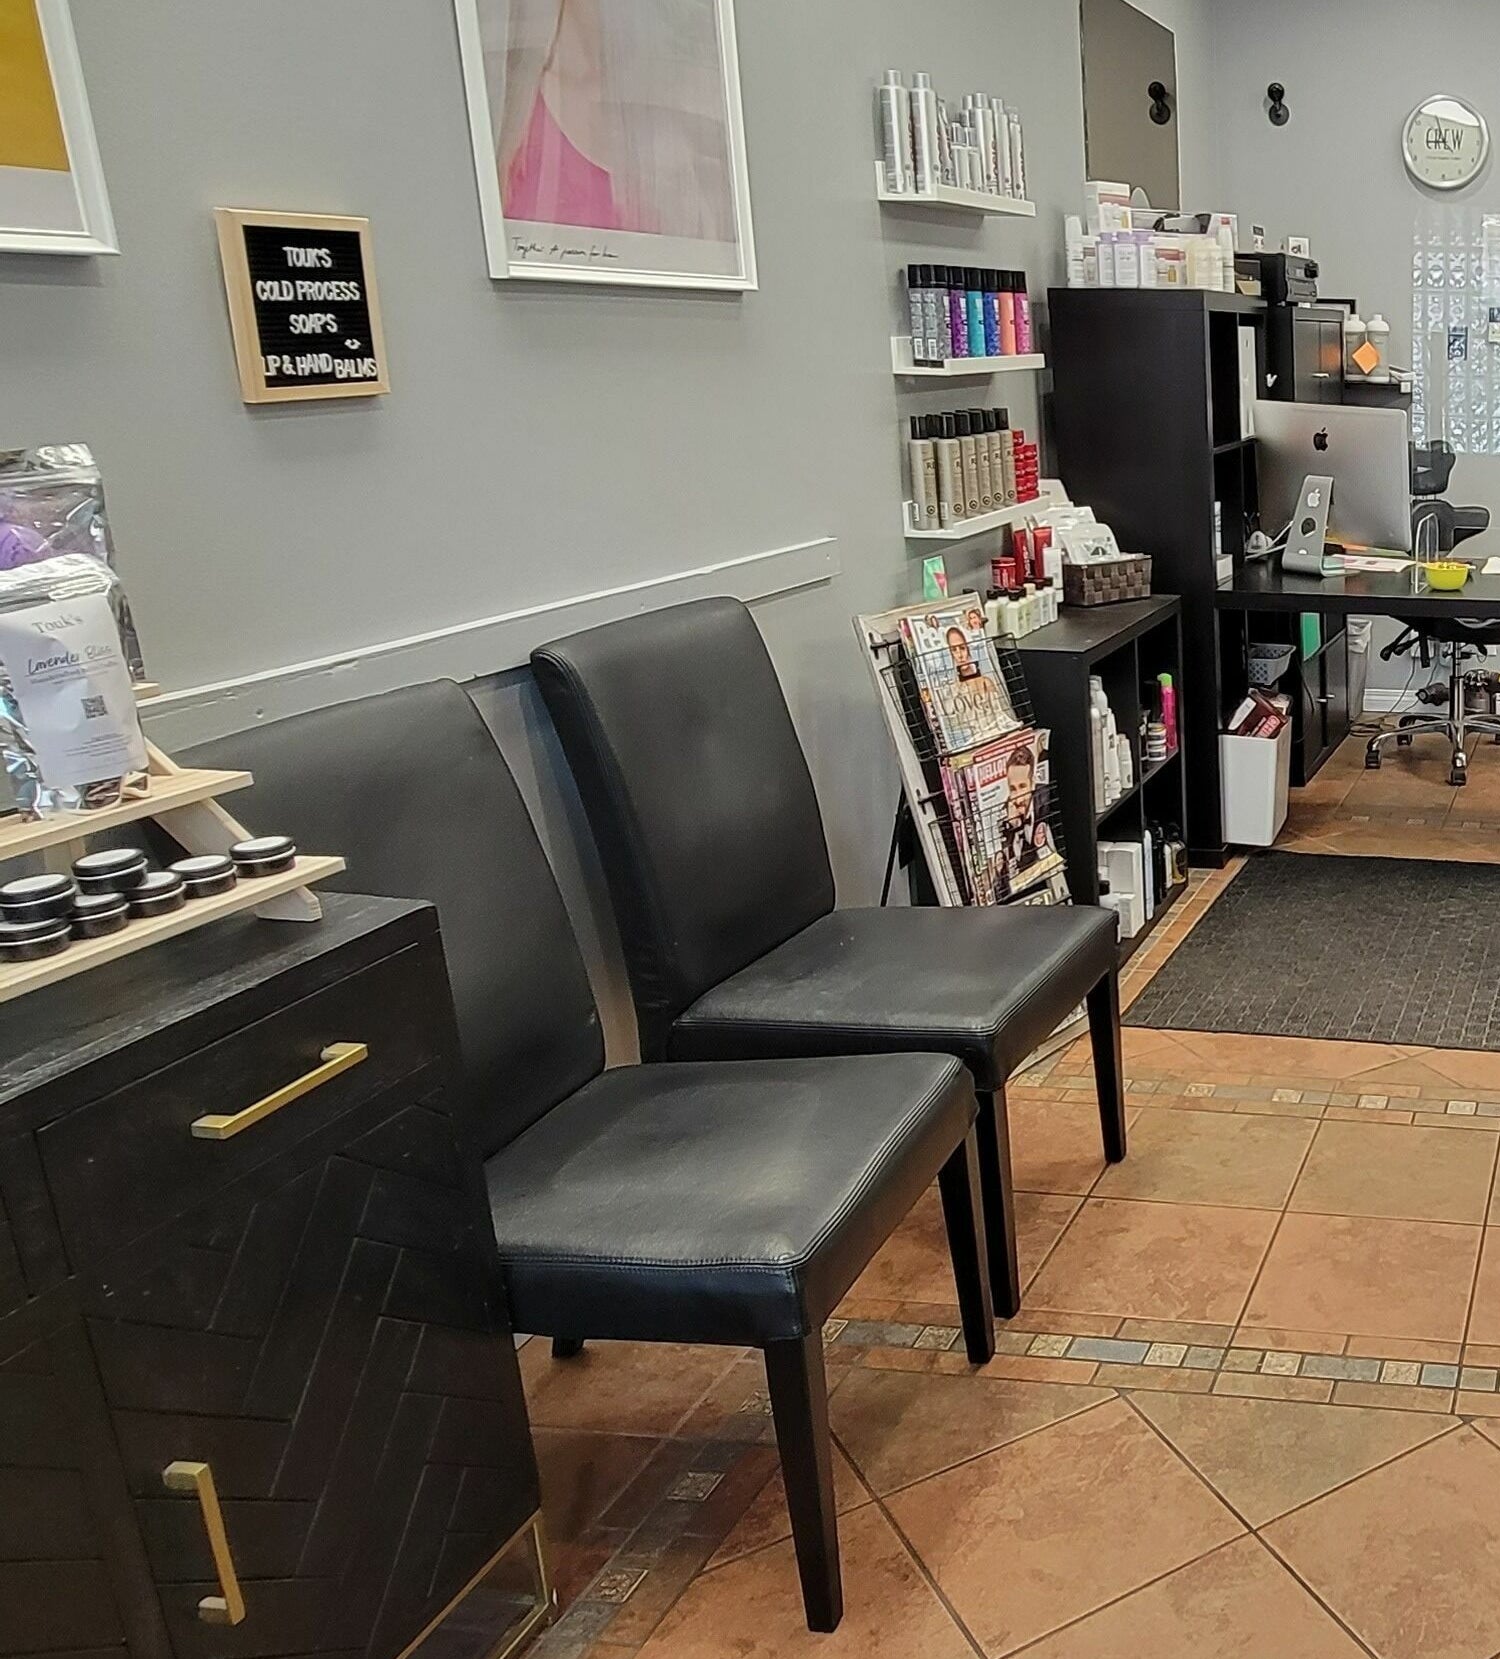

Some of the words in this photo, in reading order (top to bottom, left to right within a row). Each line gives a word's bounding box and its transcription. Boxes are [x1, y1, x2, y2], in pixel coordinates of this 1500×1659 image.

[256, 280, 294, 301] COLD
[296, 280, 361, 301] PROCESS
[295, 353, 333, 376] HAND
[334, 357, 378, 378] BALMS
[32, 613, 84, 634] Touk's
